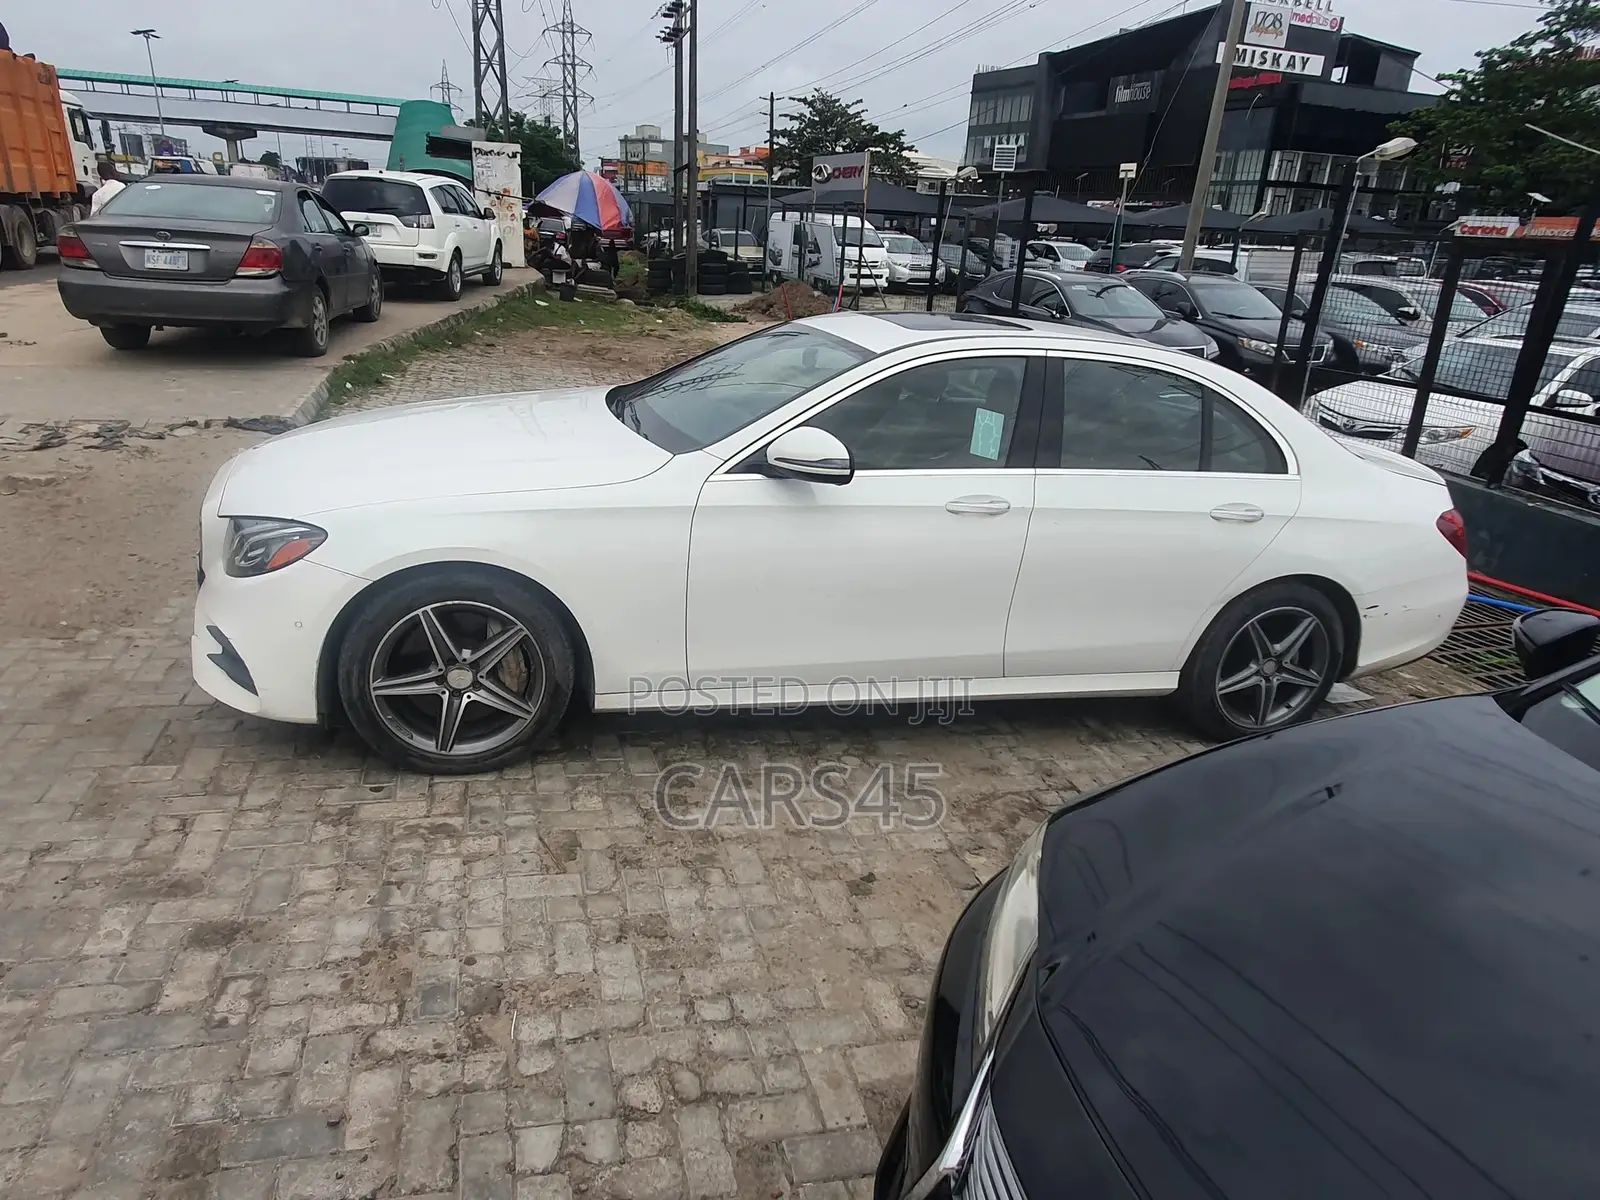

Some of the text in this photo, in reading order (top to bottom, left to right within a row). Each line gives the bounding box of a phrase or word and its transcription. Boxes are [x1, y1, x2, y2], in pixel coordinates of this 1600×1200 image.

[1254, 11, 1283, 30] 1708
[1292, 11, 1328, 27] medplus
[1233, 48, 1310, 72] MISKAY
[1114, 84, 1151, 103] filmhouse
[1523, 224, 1576, 237] Authorize
